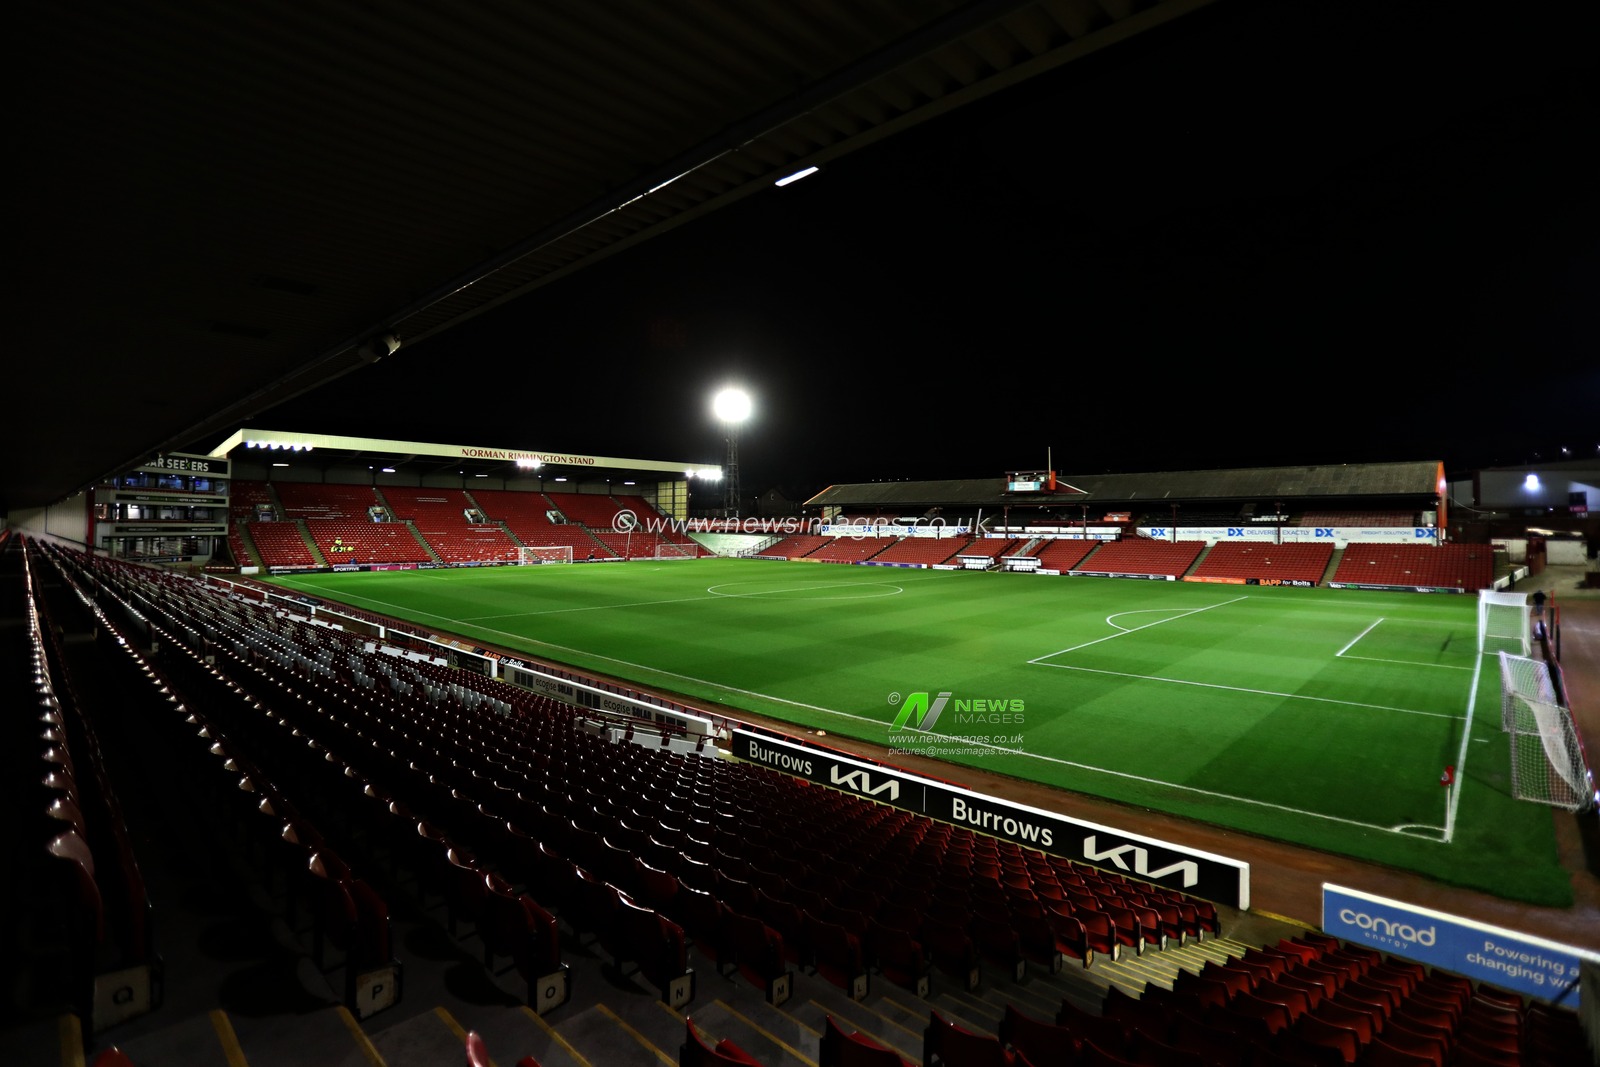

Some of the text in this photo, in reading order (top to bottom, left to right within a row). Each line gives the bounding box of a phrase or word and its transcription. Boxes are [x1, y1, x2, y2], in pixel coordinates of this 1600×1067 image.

[461, 448, 594, 465] NORMAN RIMMINGTON STAND
[167, 458, 209, 472] SEEKERS
[1151, 528, 1166, 536] DX
[1228, 528, 1244, 536] DX
[1315, 528, 1334, 538] DX
[1415, 528, 1438, 538] DX
[536, 678, 556, 692] ecogise
[604, 699, 652, 720] ecogise SOLAR
[749, 740, 812, 776] Burrows
[952, 797, 1054, 847] Burrows
[1340, 909, 1436, 946] conrad
[1364, 932, 1408, 949] energy
[1484, 941, 1565, 976] Powering
[1466, 953, 1545, 985] changing
[372, 984, 383, 1000] P
[546, 986, 556, 999] O
[676, 988, 683, 999] N
[778, 984, 784, 996] M
